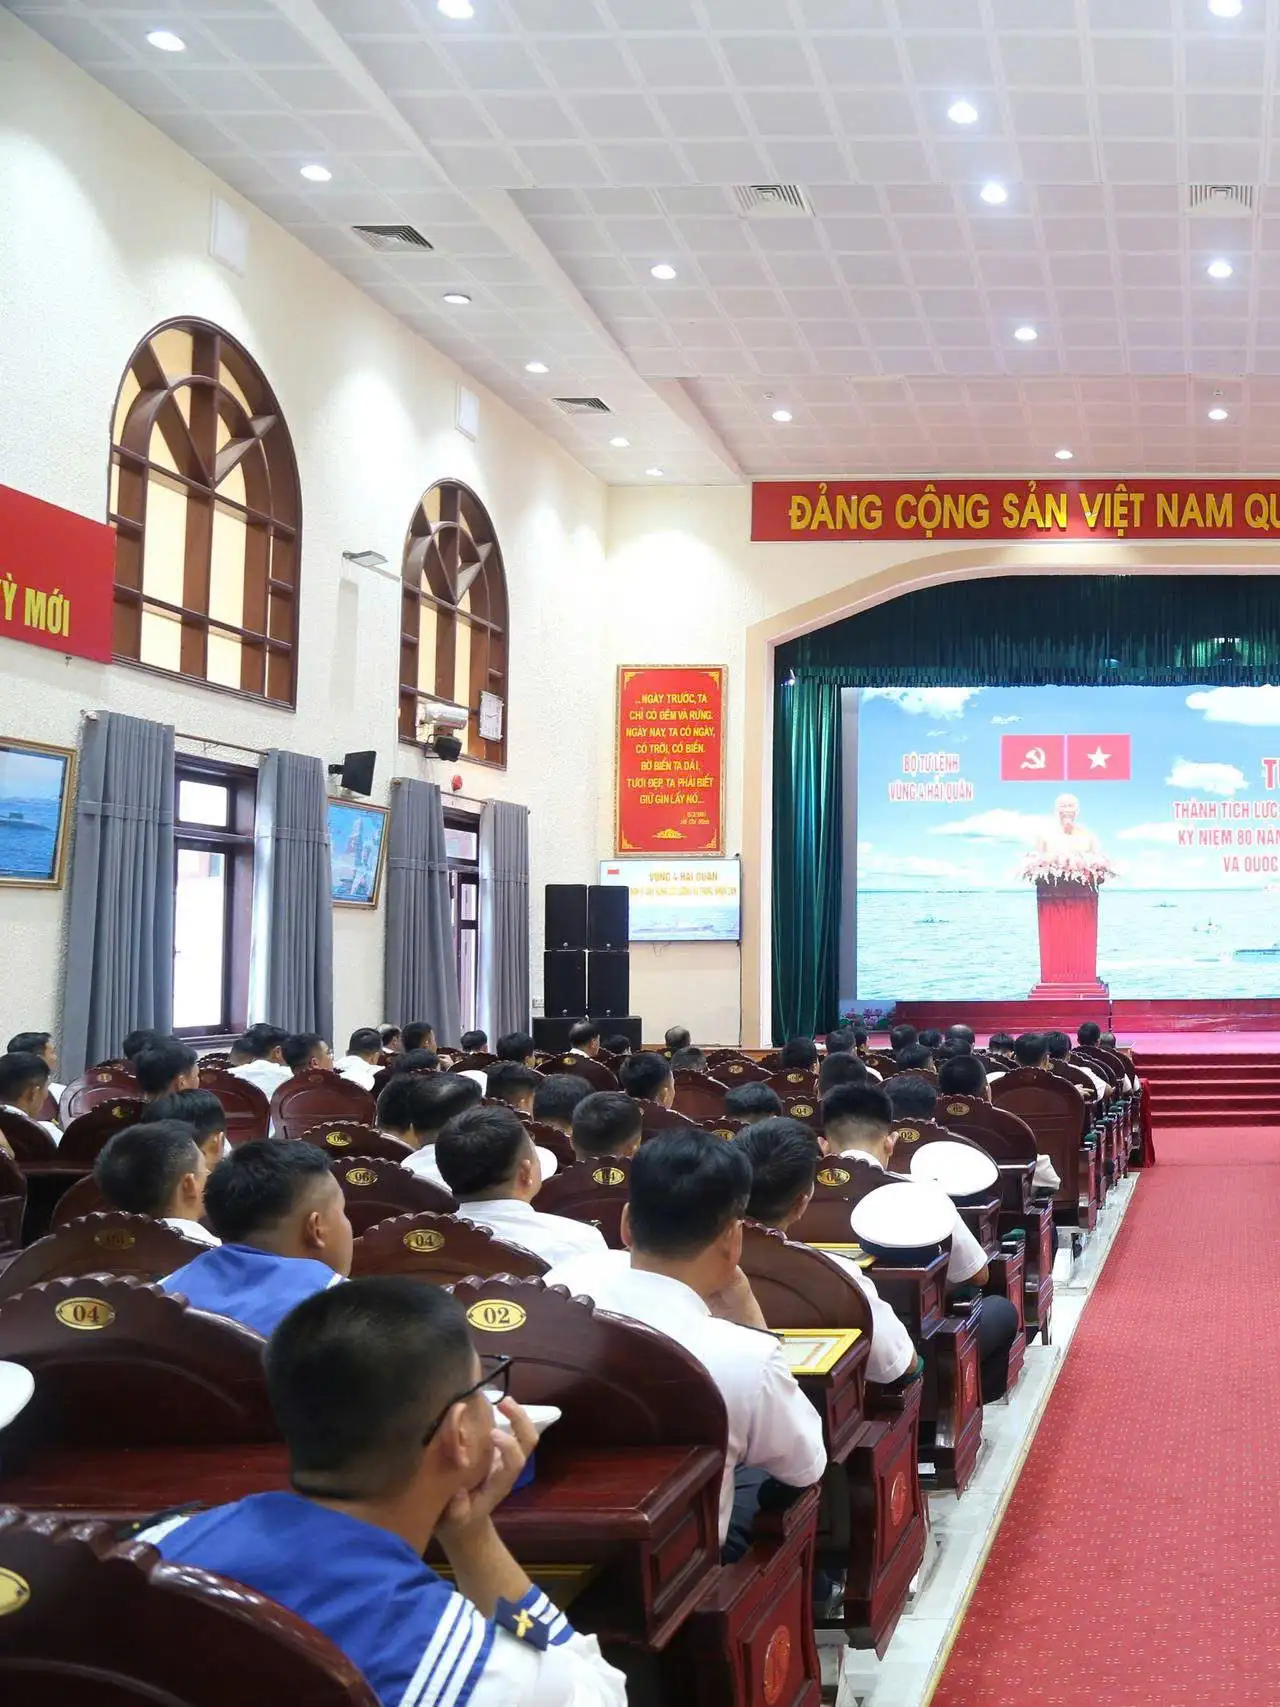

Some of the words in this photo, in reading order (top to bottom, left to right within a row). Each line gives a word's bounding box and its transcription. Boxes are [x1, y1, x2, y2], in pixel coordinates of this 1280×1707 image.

[789, 482, 883, 530] ĐẢNG
[895, 484, 990, 538] CỘNG
[1002, 480, 1068, 529] SẢN
[1079, 483, 1144, 537] VIỆT
[1156, 493, 1233, 528] NAM
[24, 587, 70, 638] MỚI
[697, 694, 708, 703] TA
[669, 728, 678, 737] TA
[1237, 830, 1252, 845] 80
[415, 1234, 433, 1247] 04
[73, 1305, 98, 1322] 04
[484, 1308, 510, 1324] 02
